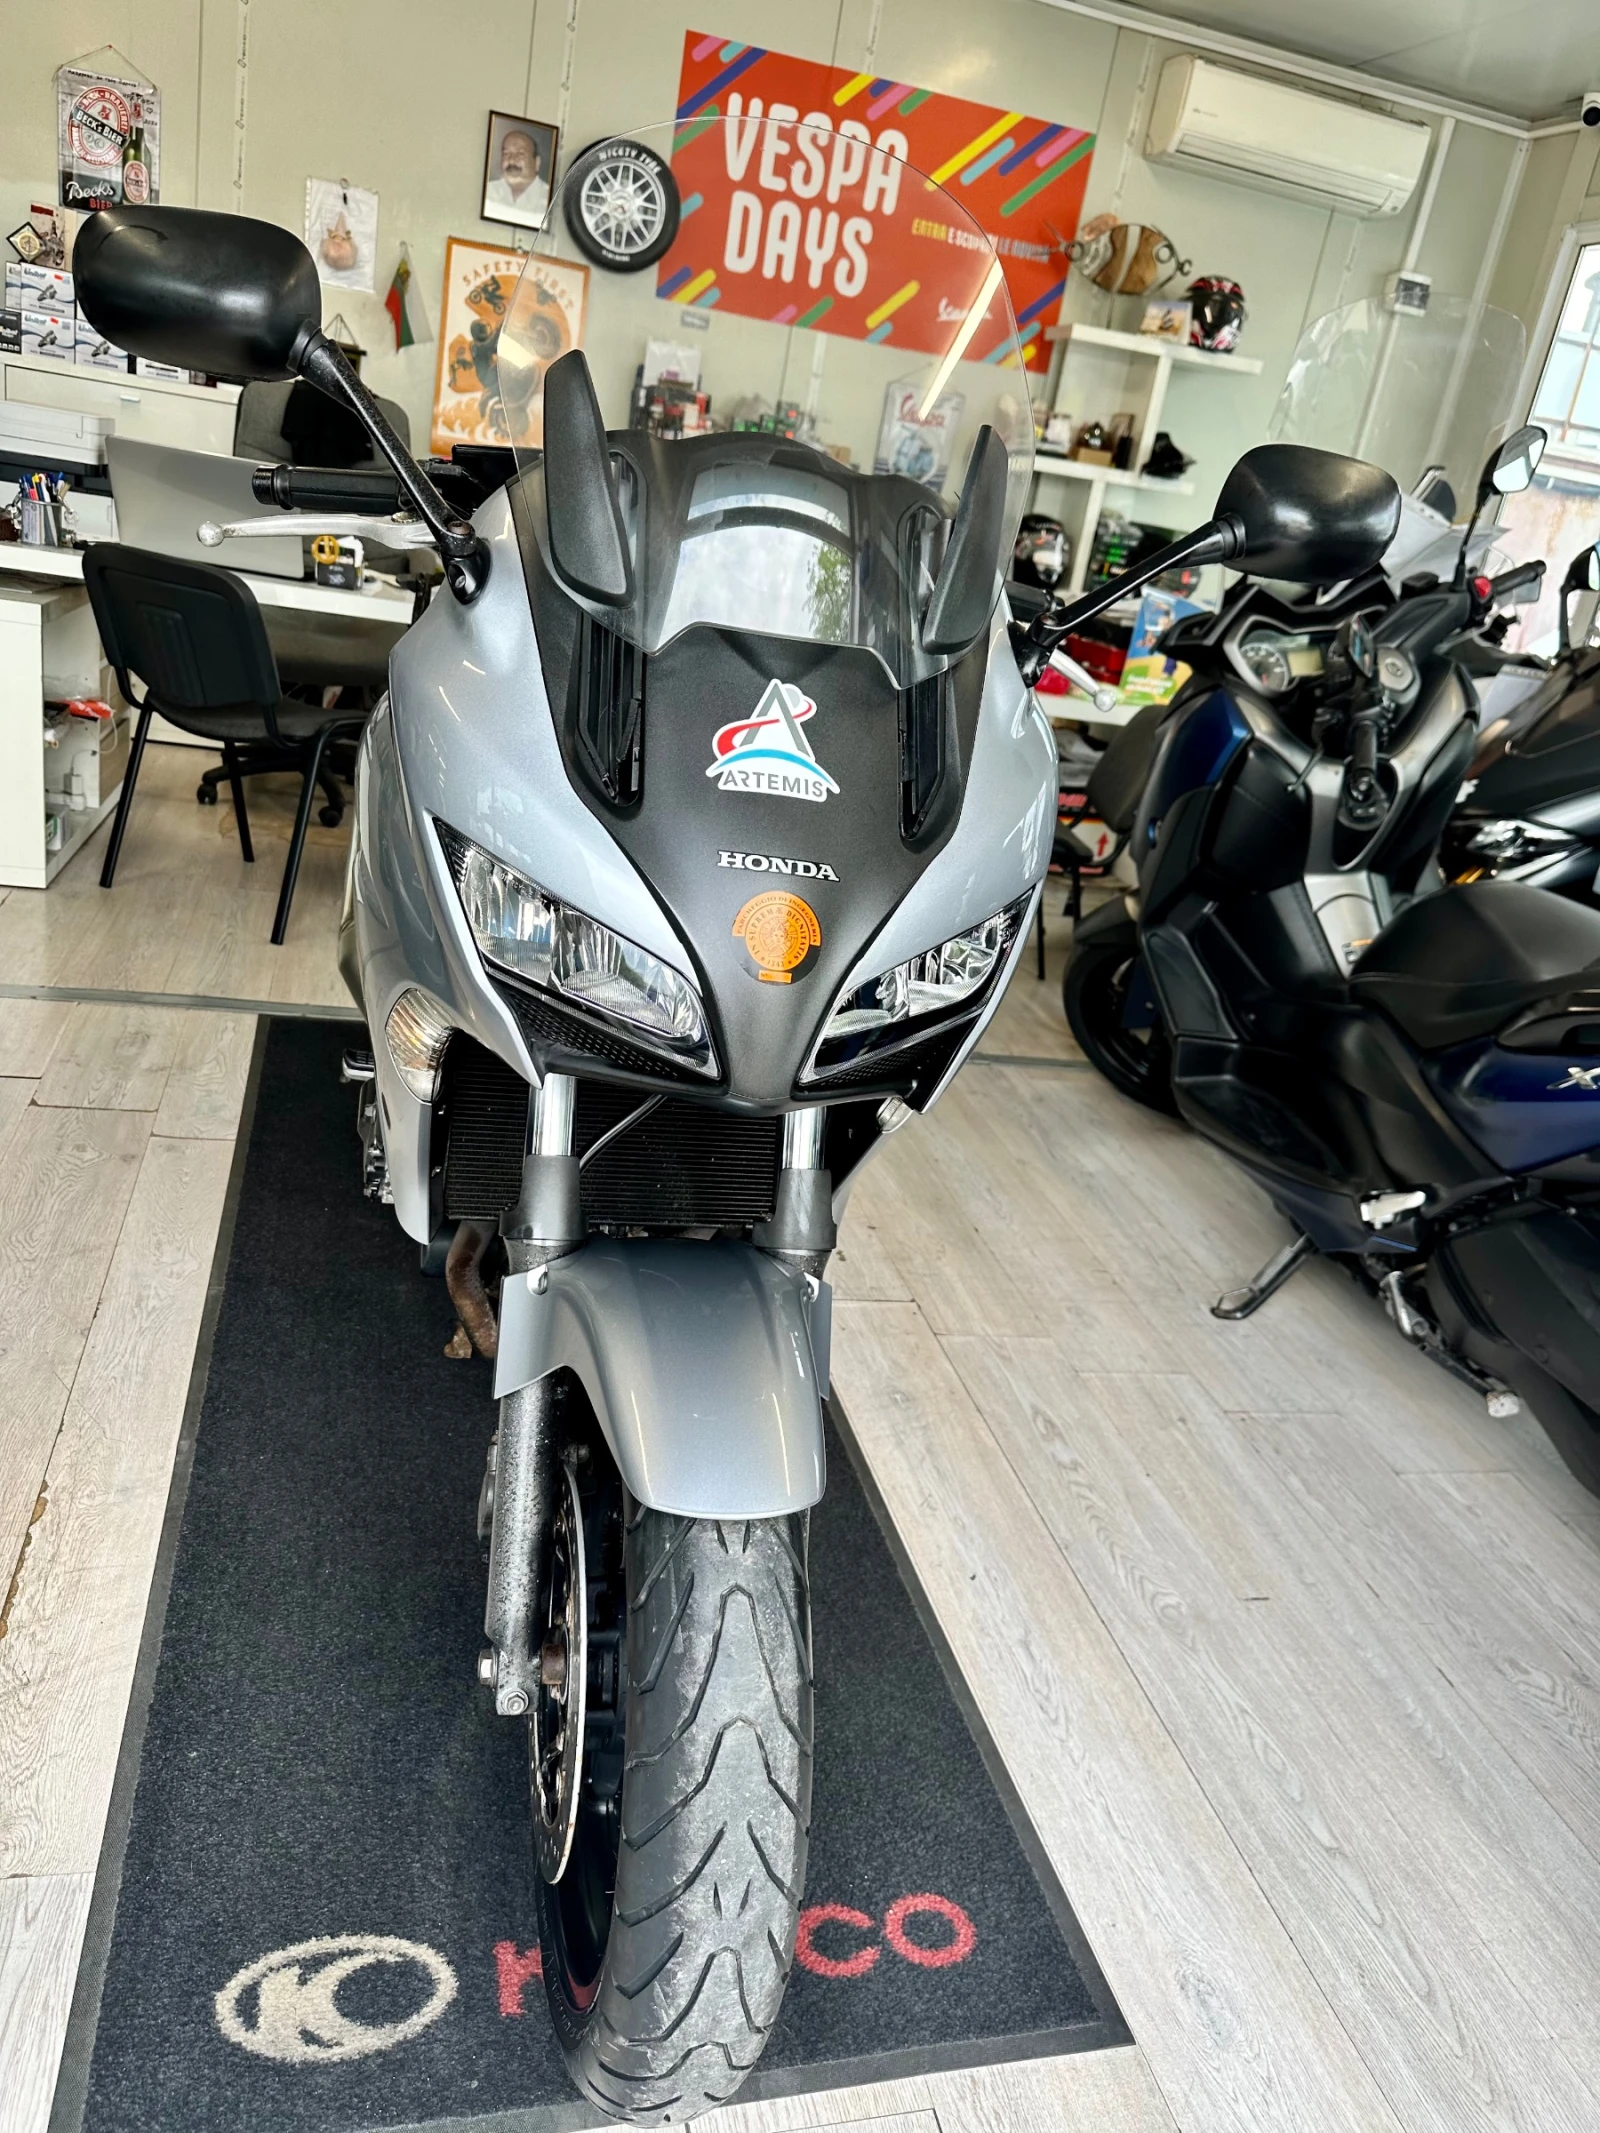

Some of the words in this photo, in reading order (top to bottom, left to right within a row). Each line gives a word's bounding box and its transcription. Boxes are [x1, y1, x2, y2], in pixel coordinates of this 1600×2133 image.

[102, 126, 123, 146] BIER
[725, 92, 909, 216] VESPA
[724, 190, 874, 298] DAYS
[911, 218, 948, 241] ENTRA
[463, 260, 525, 287] SAFETY
[722, 769, 824, 798] ARTEMIS
[717, 851, 840, 881] HONDA
[737, 896, 777, 935] PARCHEGGIO
[788, 897, 818, 943] INGEGNERIA
[751, 944, 760, 955] IN
[786, 910, 807, 960] DIGNITATIS
